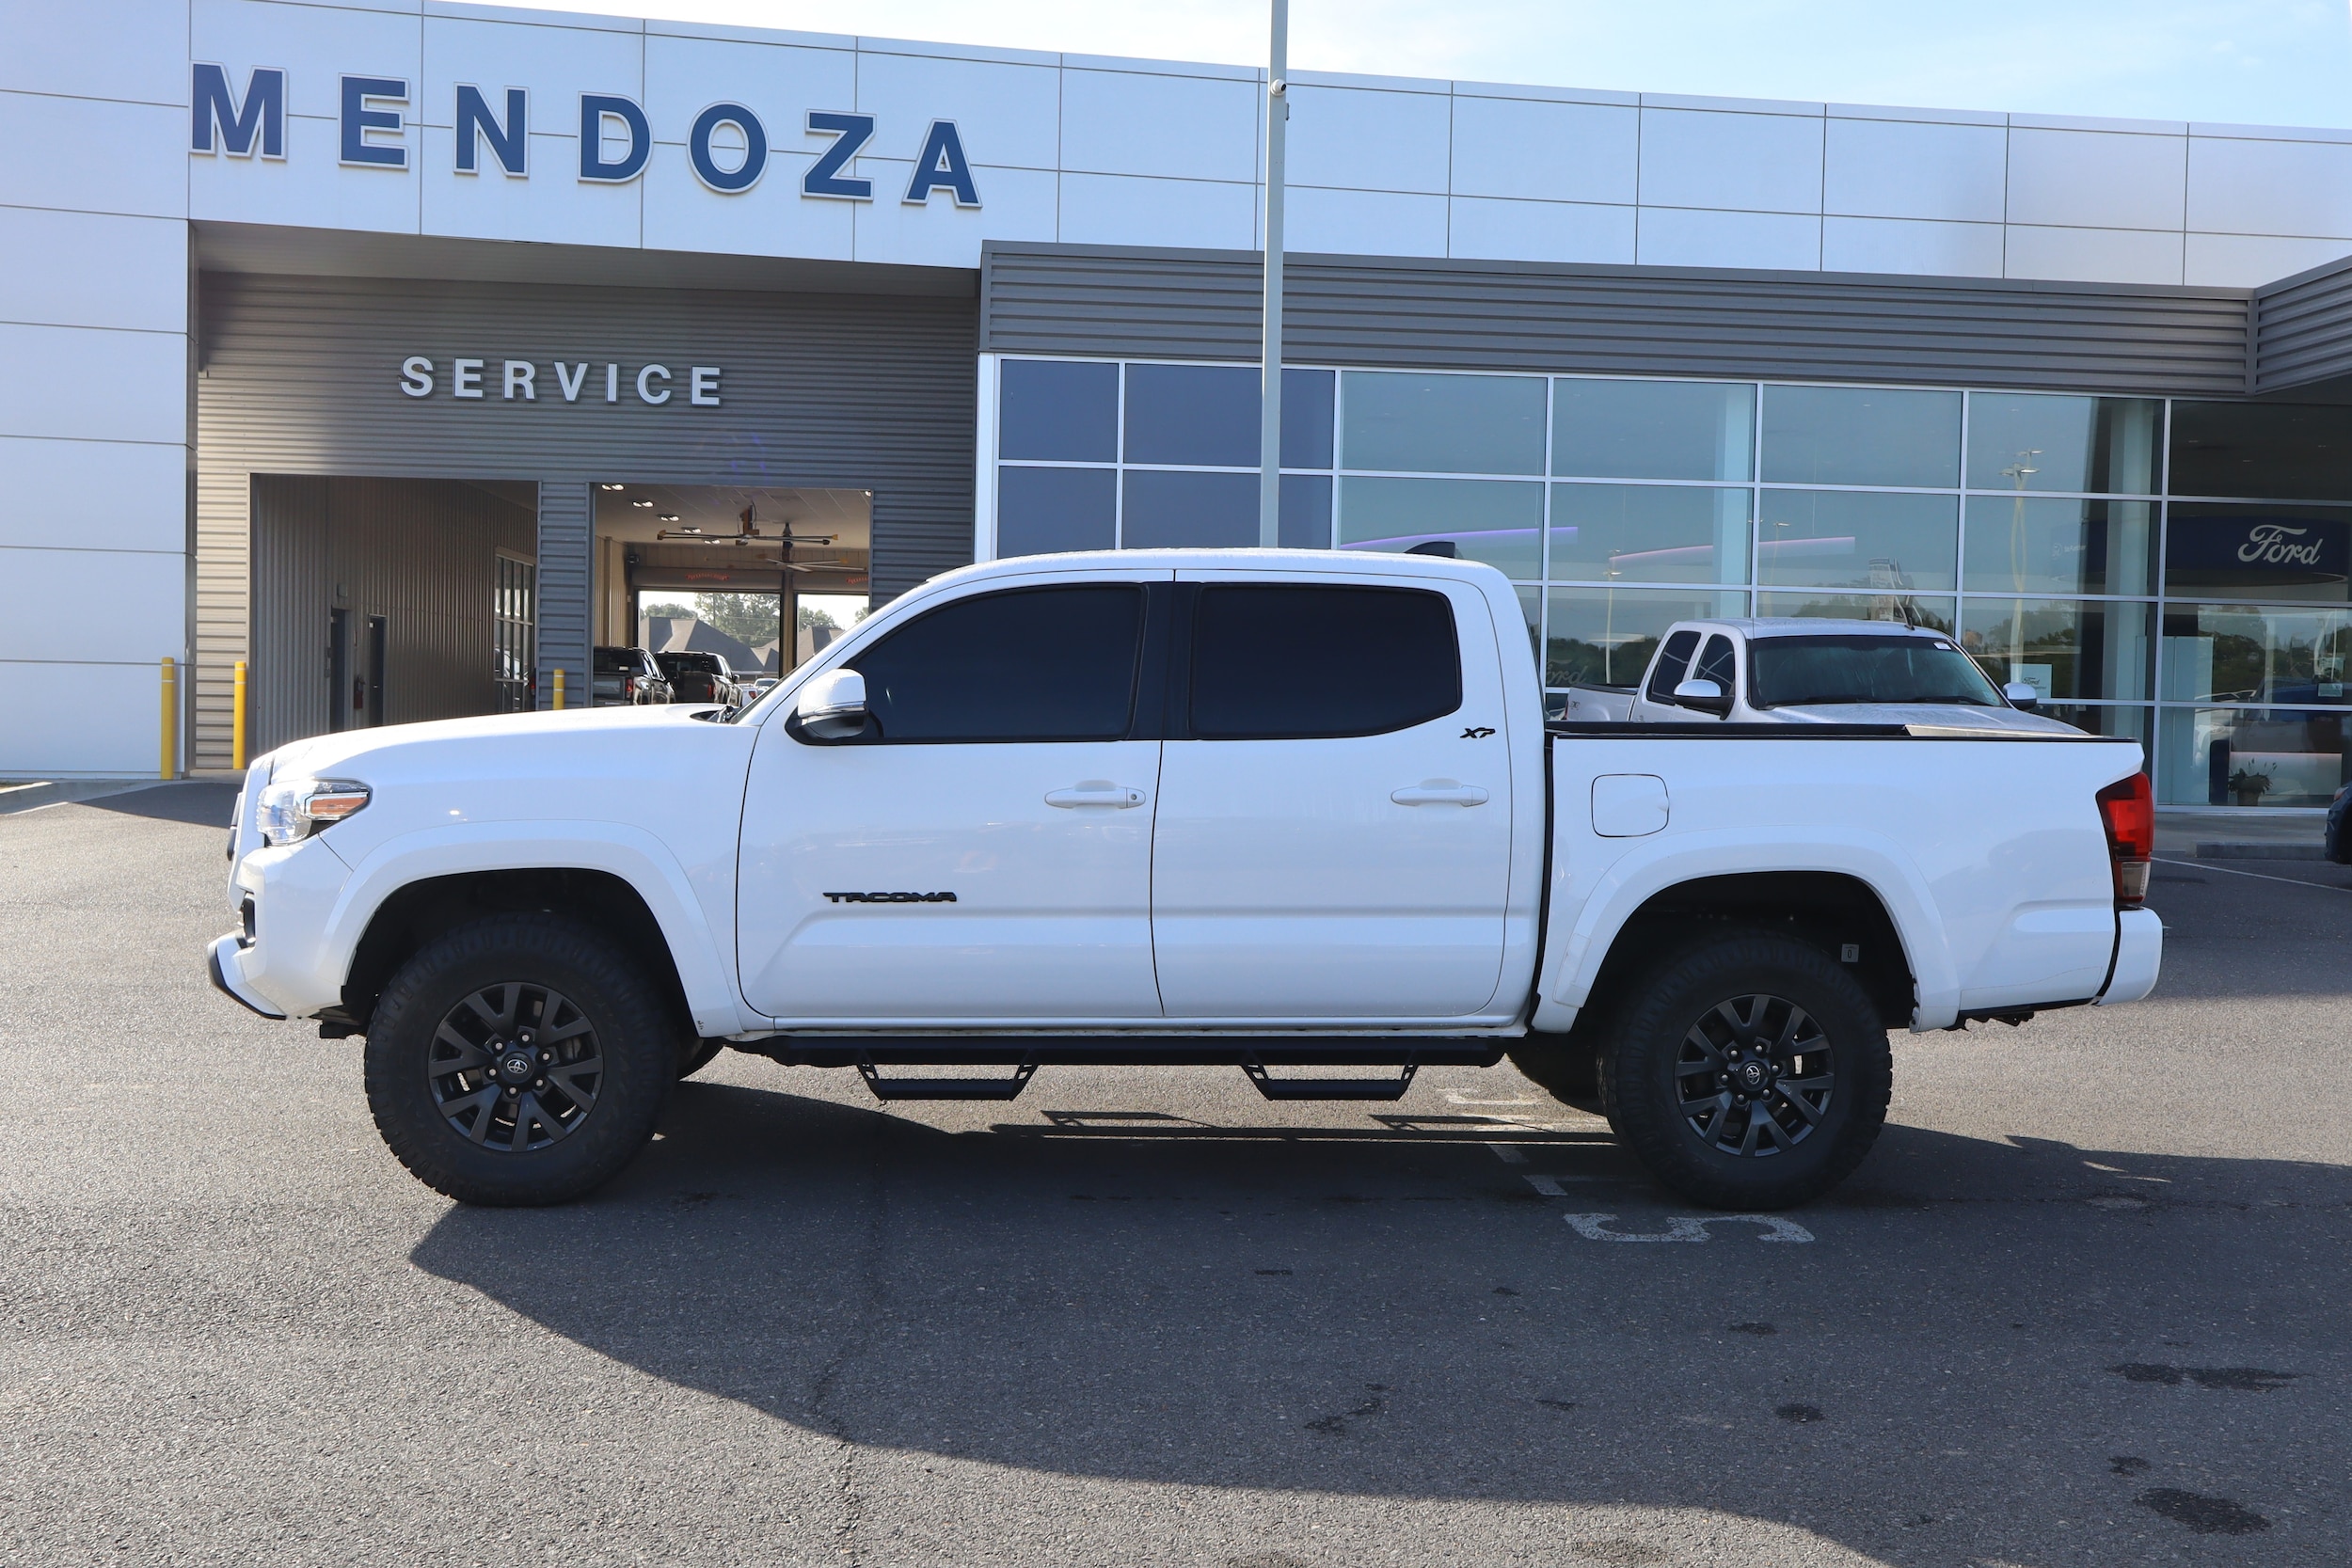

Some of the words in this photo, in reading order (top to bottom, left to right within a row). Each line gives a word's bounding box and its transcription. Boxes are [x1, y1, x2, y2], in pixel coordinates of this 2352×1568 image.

[190, 61, 983, 209] MENDOZA
[399, 355, 723, 407] SERVICE
[2237, 524, 2324, 565] Ford
[1459, 727, 1496, 738] XP
[822, 892, 958, 903] TACOMA
